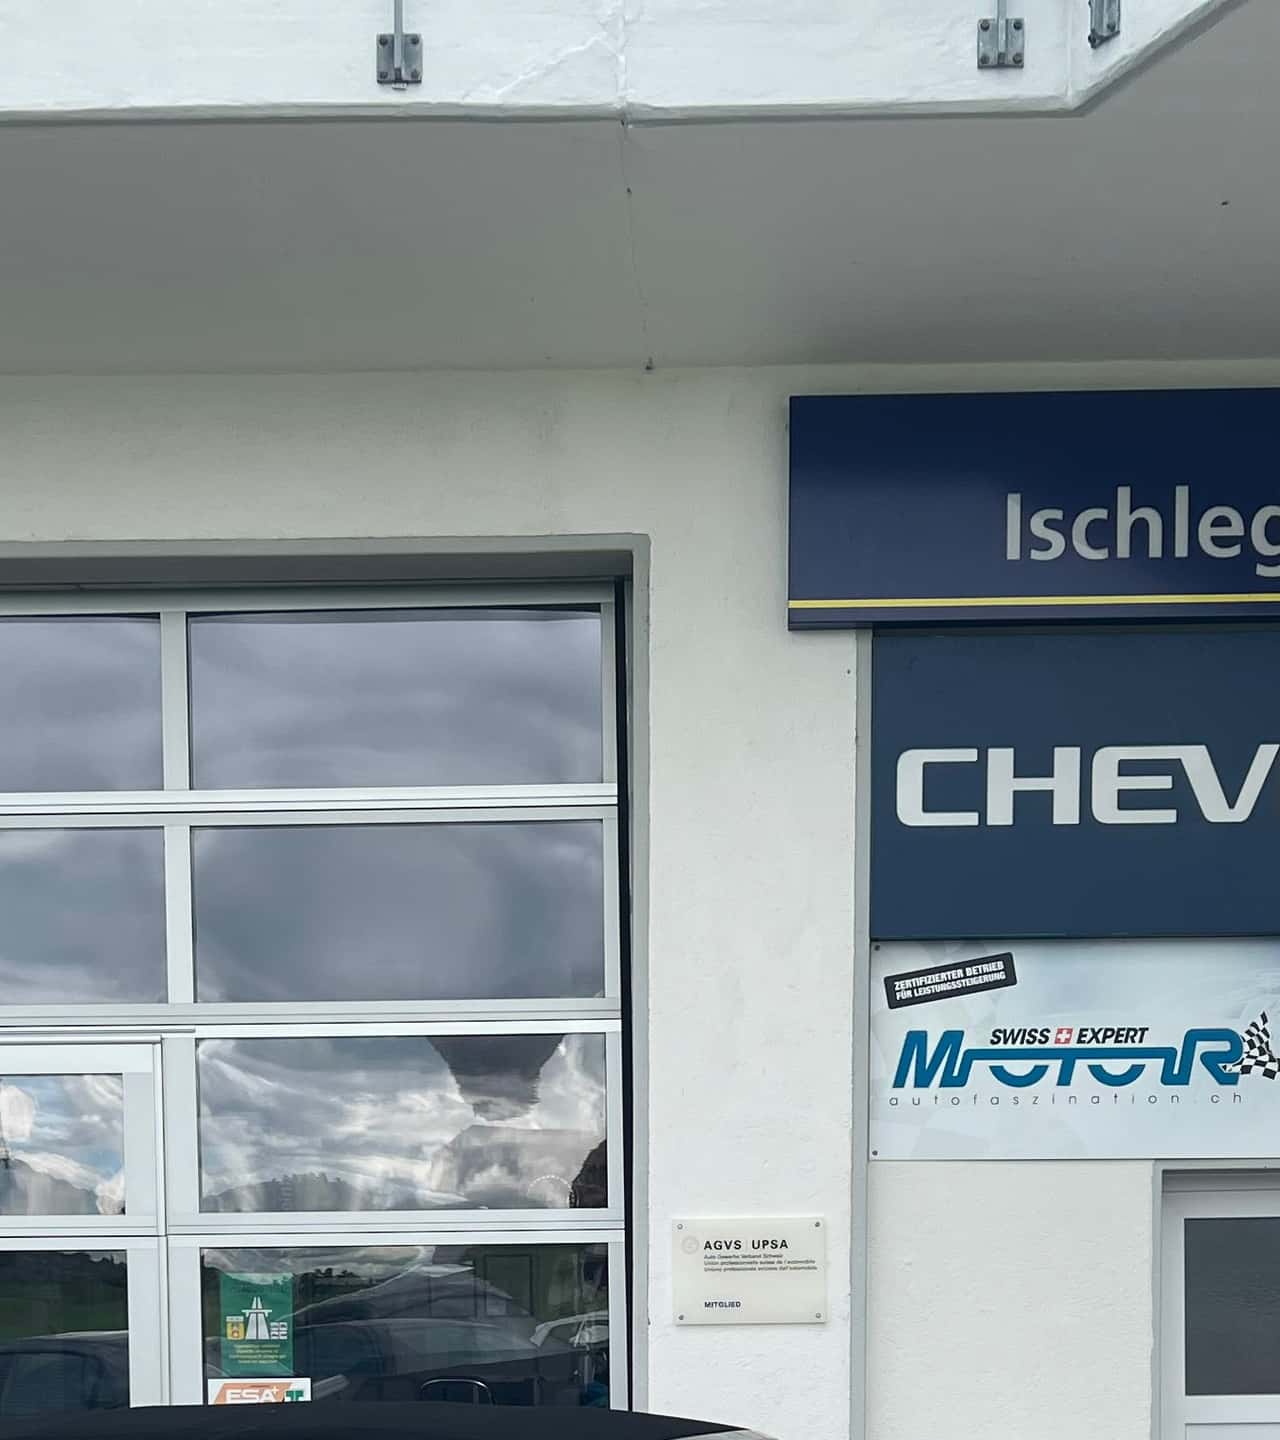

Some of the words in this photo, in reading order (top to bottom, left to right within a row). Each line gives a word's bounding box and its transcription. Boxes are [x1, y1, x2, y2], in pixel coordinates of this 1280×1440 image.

[894, 968, 964, 991] ZERTIFIZIERTER
[965, 960, 1005, 978] BETRIEB
[895, 989, 913, 1001] FÜR
[989, 1027, 1051, 1046] SWISS
[1075, 1026, 1150, 1045] EXPERT
[703, 1239, 742, 1250] AGVS
[751, 1239, 789, 1250] UPSA
